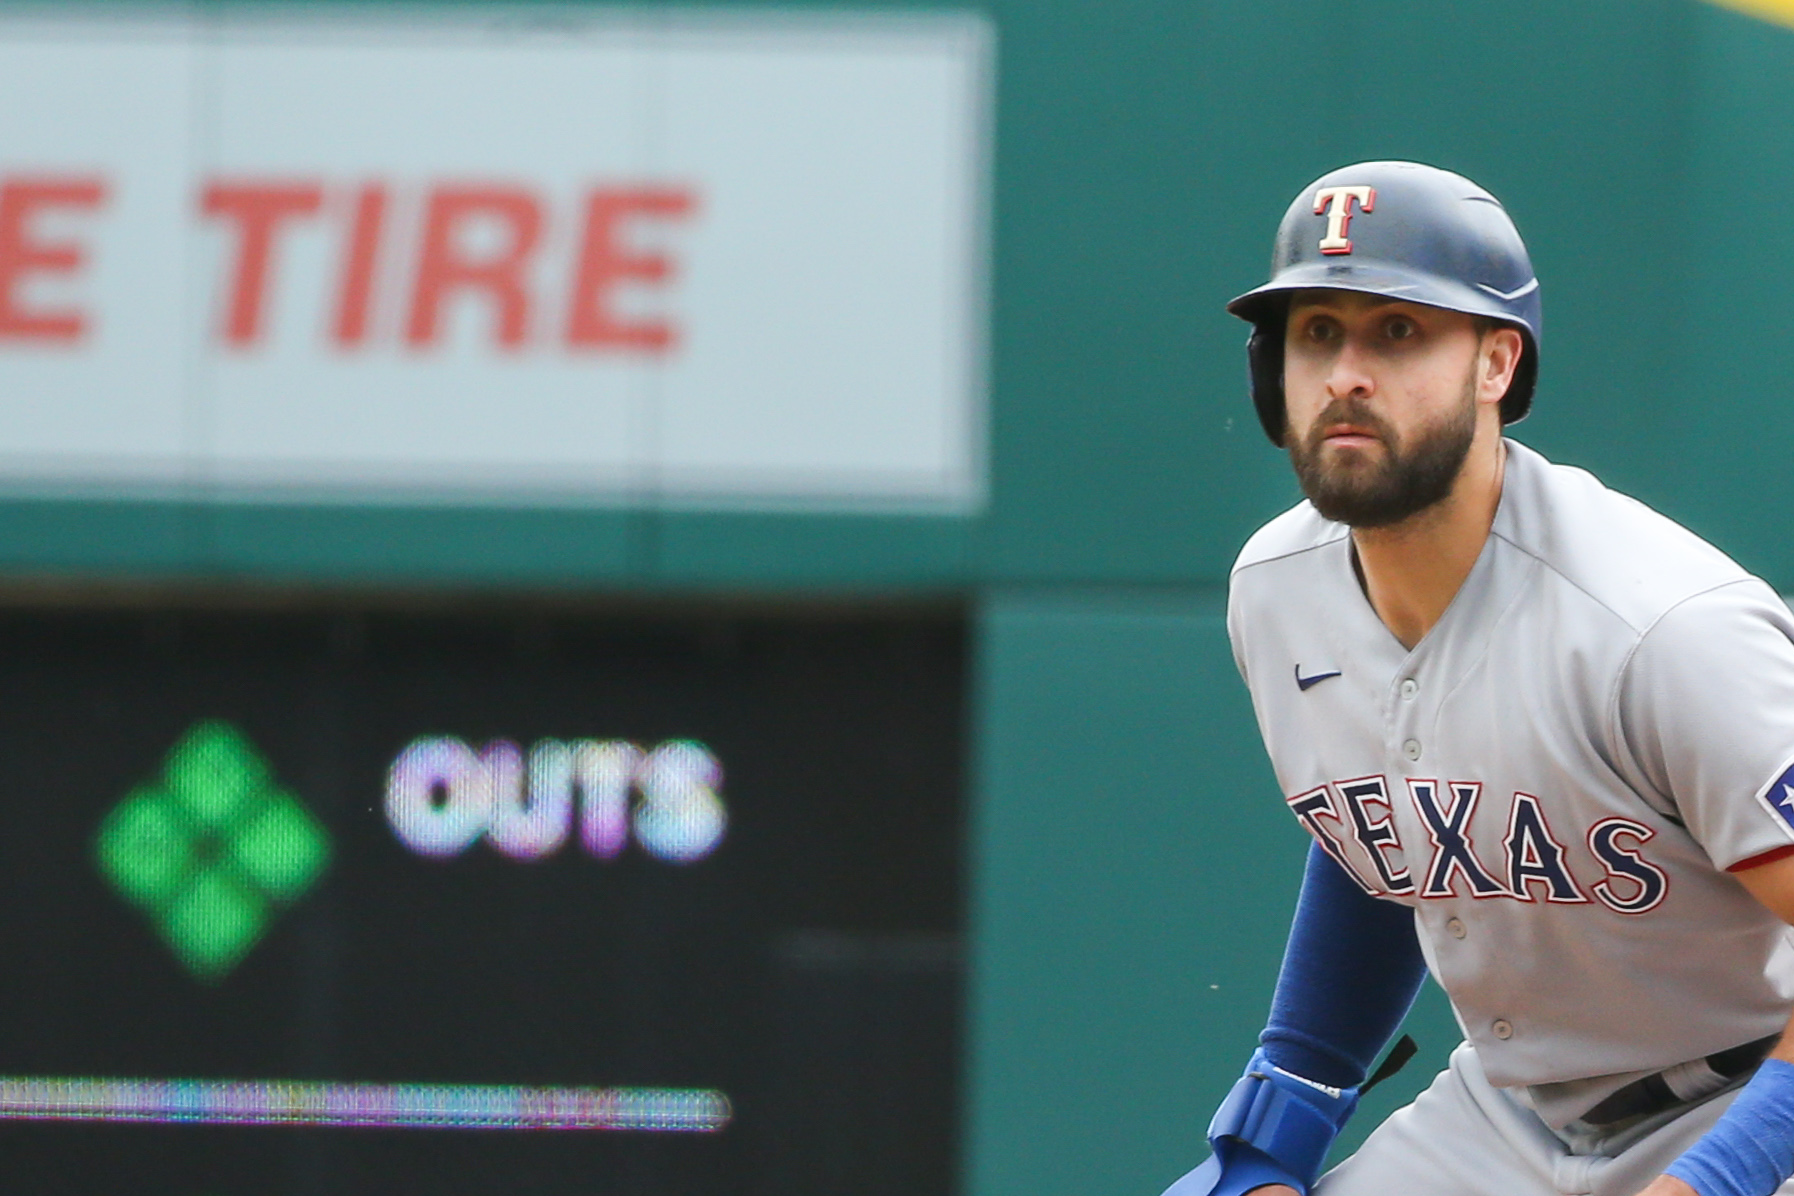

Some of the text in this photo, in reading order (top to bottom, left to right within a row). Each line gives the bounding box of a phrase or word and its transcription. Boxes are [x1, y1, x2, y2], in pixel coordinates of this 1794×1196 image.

[198, 179, 696, 354] TIRE
[1312, 185, 1377, 255] T
[384, 737, 727, 862] OUTS
[1287, 774, 1670, 915] TEXAS
